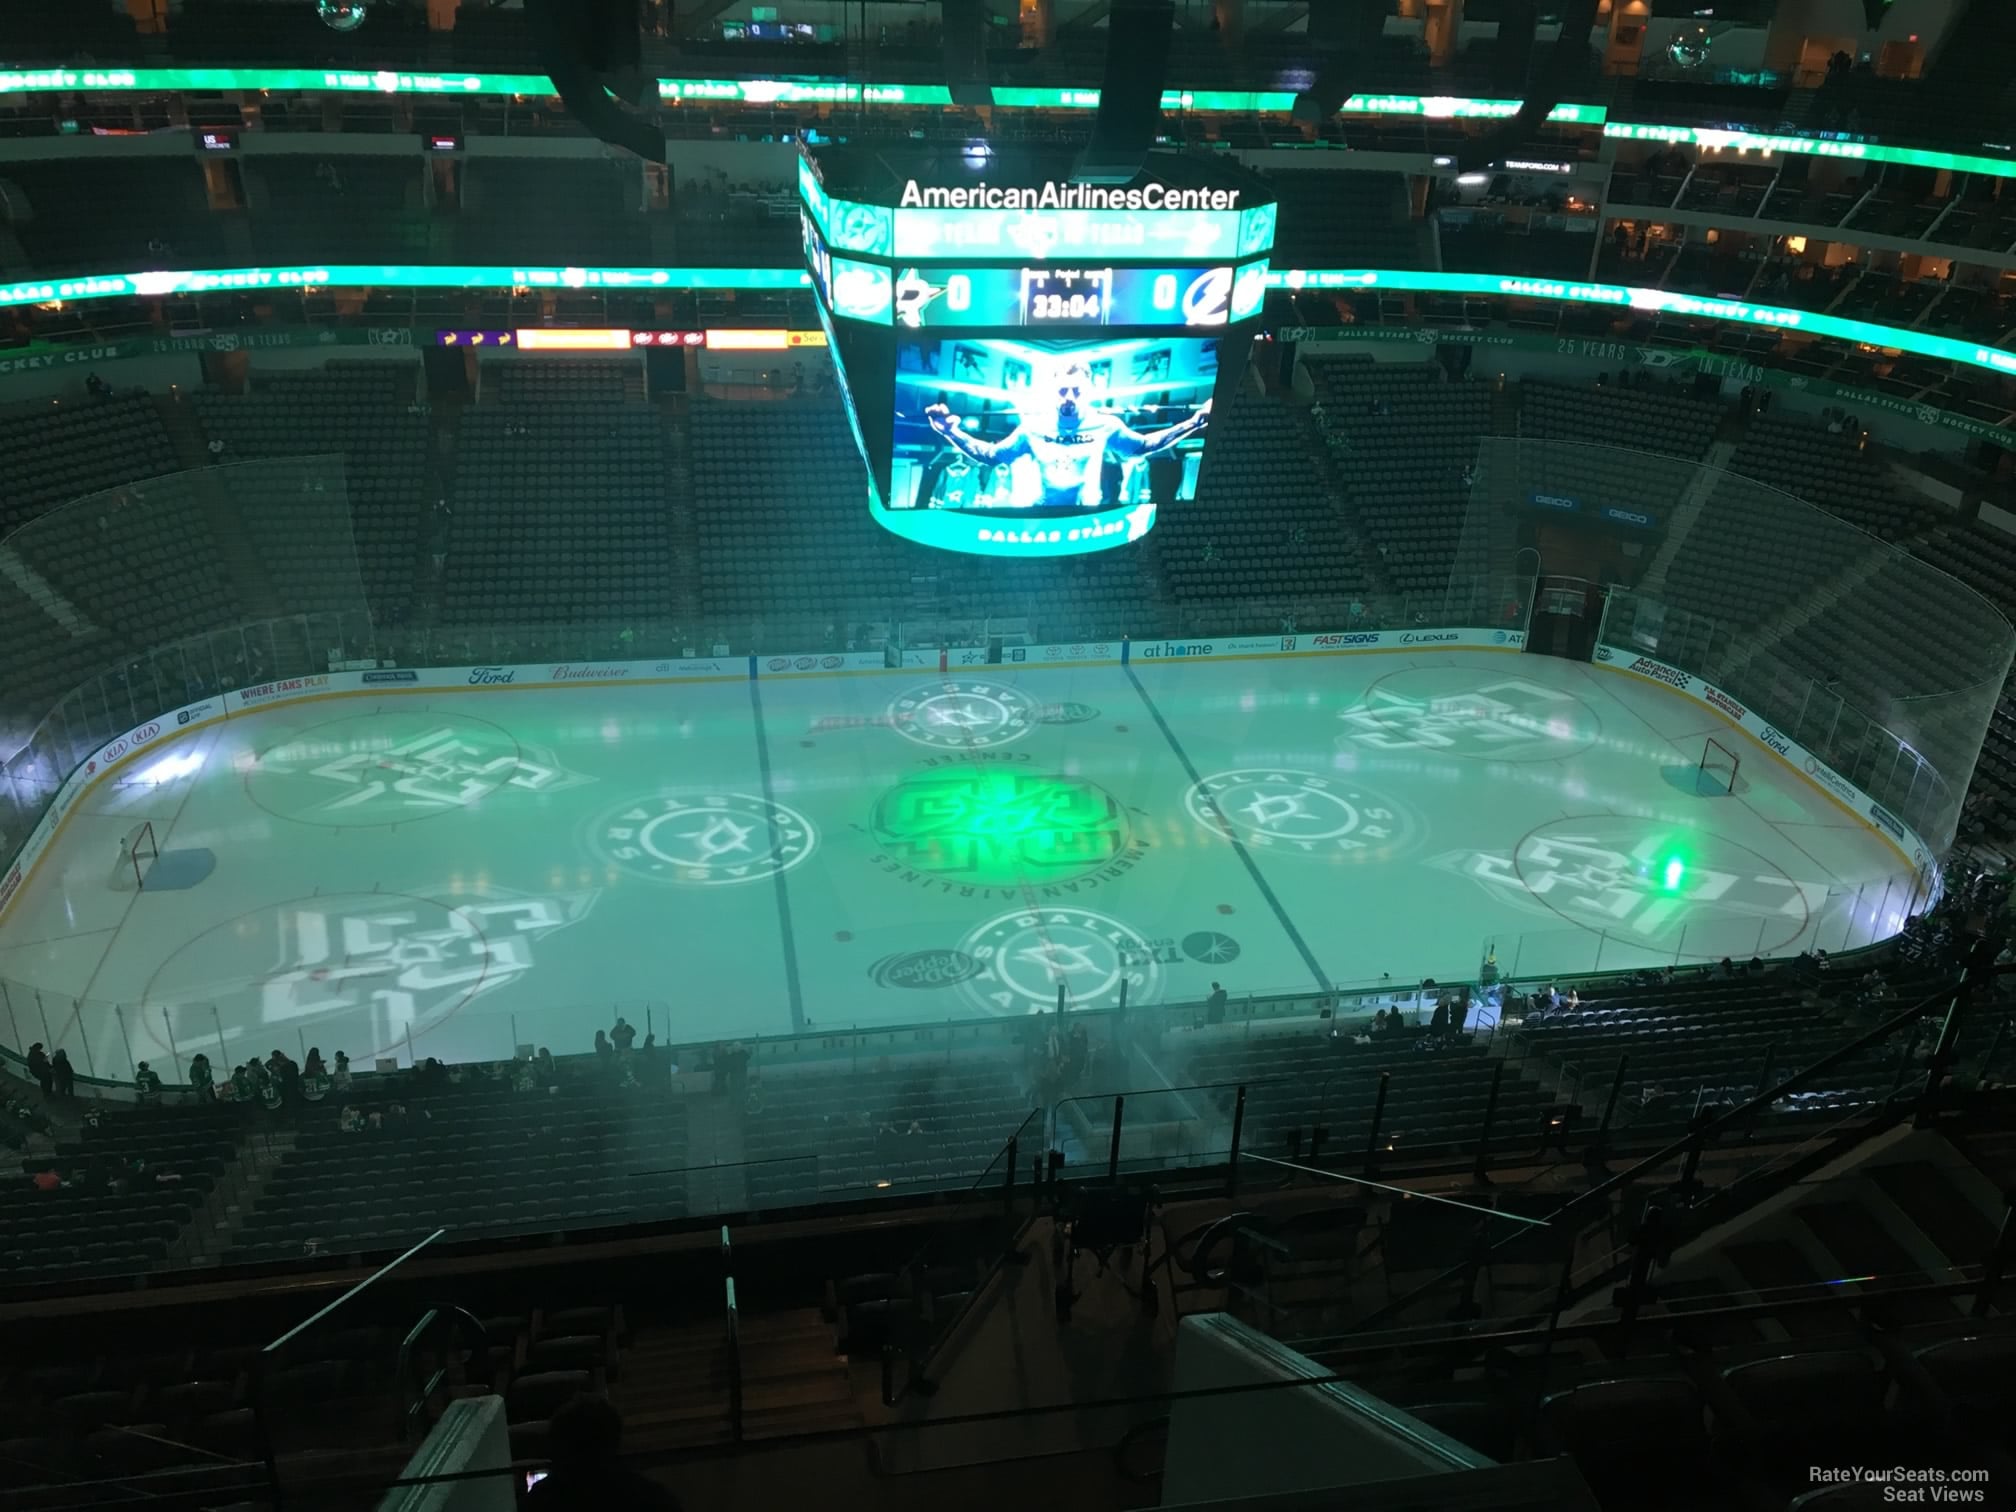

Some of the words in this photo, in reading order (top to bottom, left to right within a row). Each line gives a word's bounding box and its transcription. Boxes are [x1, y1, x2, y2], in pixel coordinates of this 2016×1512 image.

[900, 180, 1240, 210] AmericanAirlinesCenter
[947, 274, 971, 311] 0
[1154, 274, 1177, 311] 0
[64, 347, 118, 362] CLUB
[1557, 338, 1575, 355] 25
[1582, 341, 1626, 361] YEARS
[1697, 357, 1713, 374] IN
[1721, 360, 1766, 383] TEXAS
[1836, 389, 1879, 405] DALLAS
[1881, 398, 1914, 415] STARS
[1942, 417, 1986, 435] HOCKEY
[1988, 430, 2014, 446] CLUB
[1535, 495, 1573, 508] GEICO
[1608, 508, 1647, 524] GEICO
[1313, 633, 1380, 645] FASTSIGNS
[1412, 632, 1459, 643] LEXUS
[1143, 642, 1161, 658] at
[468, 667, 515, 685] Ford
[551, 665, 629, 681] Budweiser
[1629, 662, 1651, 676] Auto
[1651, 668, 1674, 684] Parts
[1636, 657, 1678, 678] Advance
[240, 683, 275, 701] WHERE
[276, 679, 303, 694] FANS
[304, 675, 330, 689] PLAY
[135, 727, 157, 743] KIA
[1760, 725, 1791, 756] Ford
[105, 744, 126, 760] KIA
[869, 852, 1016, 900] AIRLINES
[1041, 837, 1151, 899] AMERICAN
